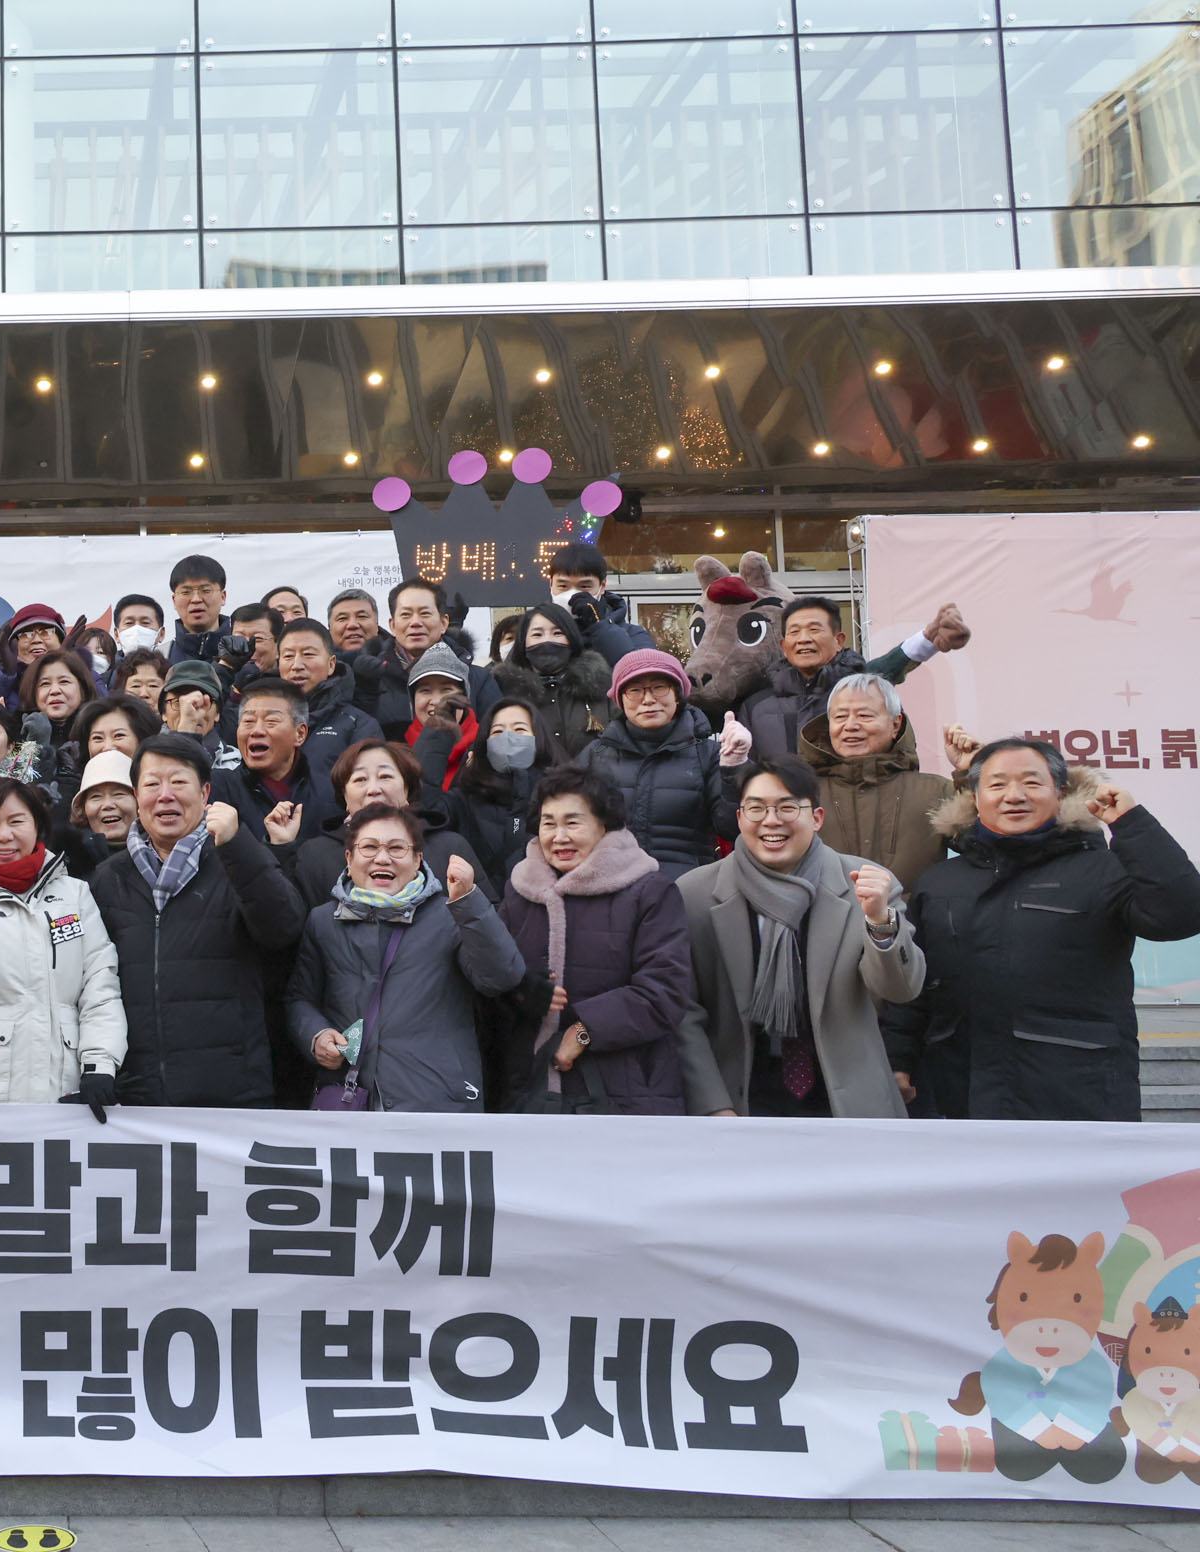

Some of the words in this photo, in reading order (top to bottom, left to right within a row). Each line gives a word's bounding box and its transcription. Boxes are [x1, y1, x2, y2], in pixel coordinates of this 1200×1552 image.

[337, 577, 363, 588] 내일이
[367, 576, 402, 587] 기다려지
[353, 565, 370, 576] 오늘
[51, 920, 85, 944] 조은희
[244, 1141, 496, 1278] 함께
[20, 1307, 263, 1442] 많이
[300, 1309, 809, 1454] 받으세요
